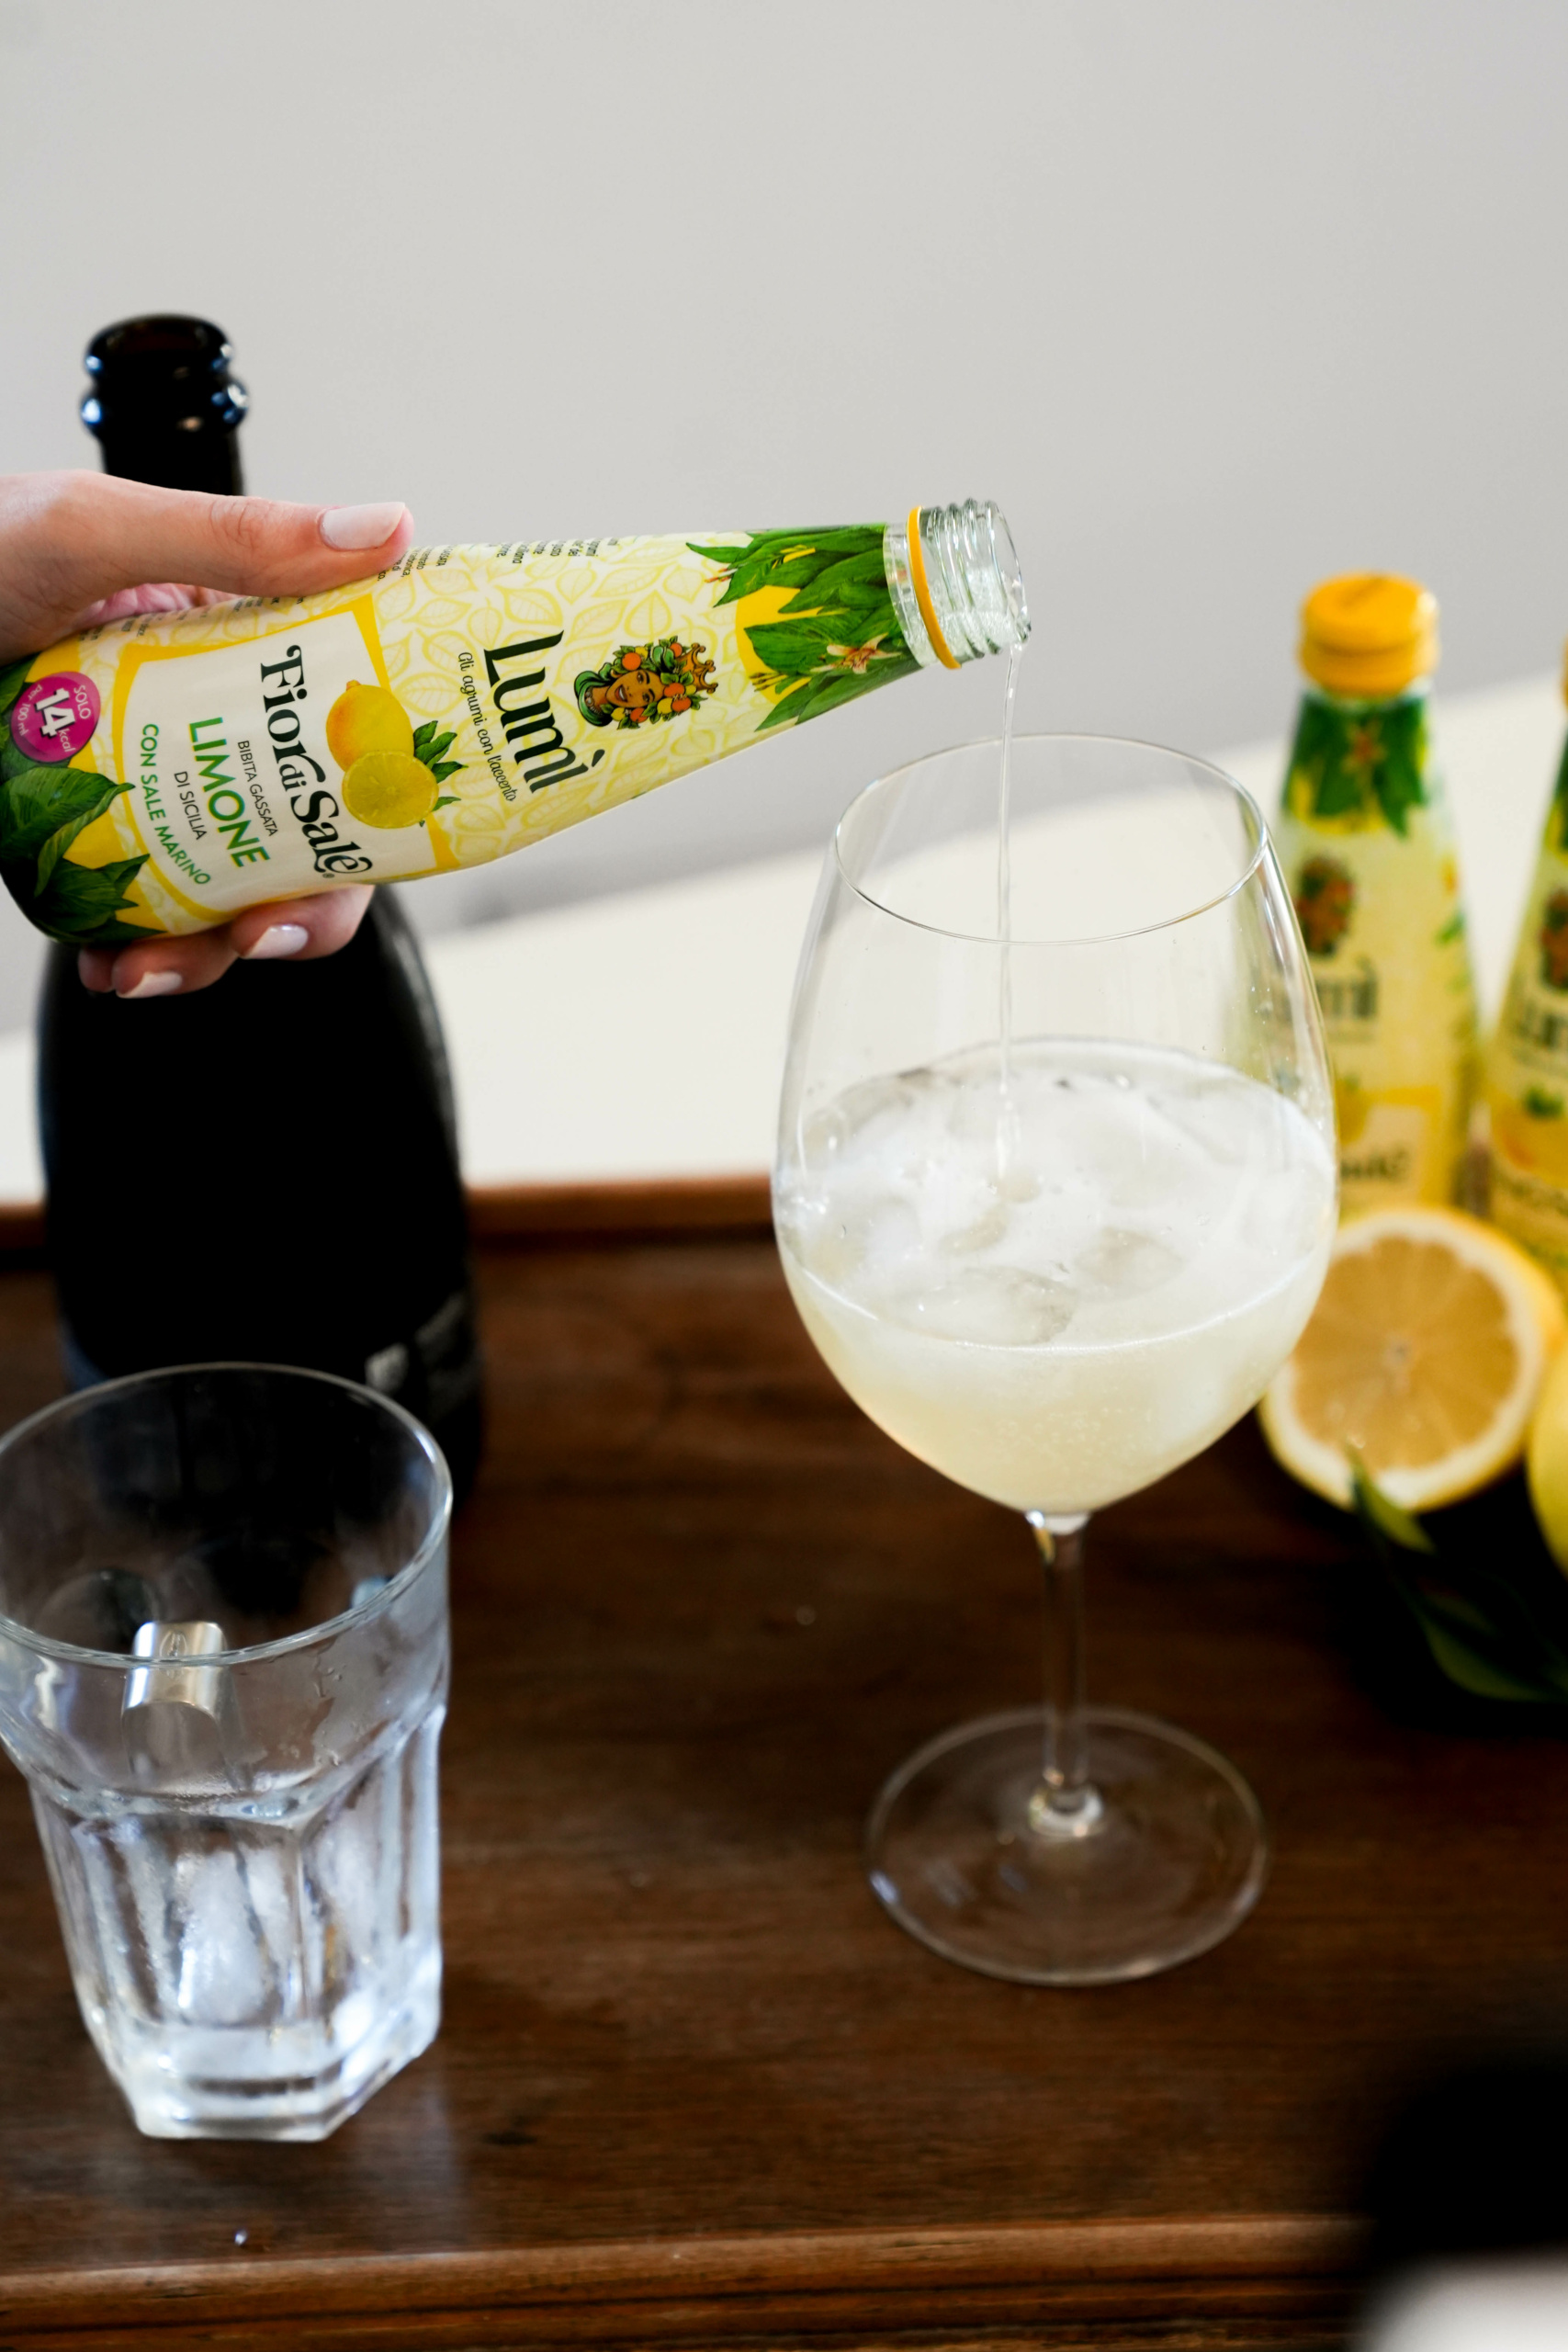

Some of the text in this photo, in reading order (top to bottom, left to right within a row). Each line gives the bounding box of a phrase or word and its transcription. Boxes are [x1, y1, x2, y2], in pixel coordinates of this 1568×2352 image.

[17, 684, 43, 737] per 100 ml
[34, 687, 75, 740] 14
[59, 728, 76, 752] kcal
[73, 684, 91, 719] SOLO
[260, 644, 326, 783] Fior
[458, 651, 518, 802] Gli agrumi con l'accento
[483, 629, 605, 794] Lumì
[140, 723, 211, 884] CON SALE MARINO
[174, 771, 208, 841] DI SICILIA
[188, 717, 271, 867] LIMONE
[238, 740, 278, 837] BIBITA GASSATA
[278, 763, 307, 792] di
